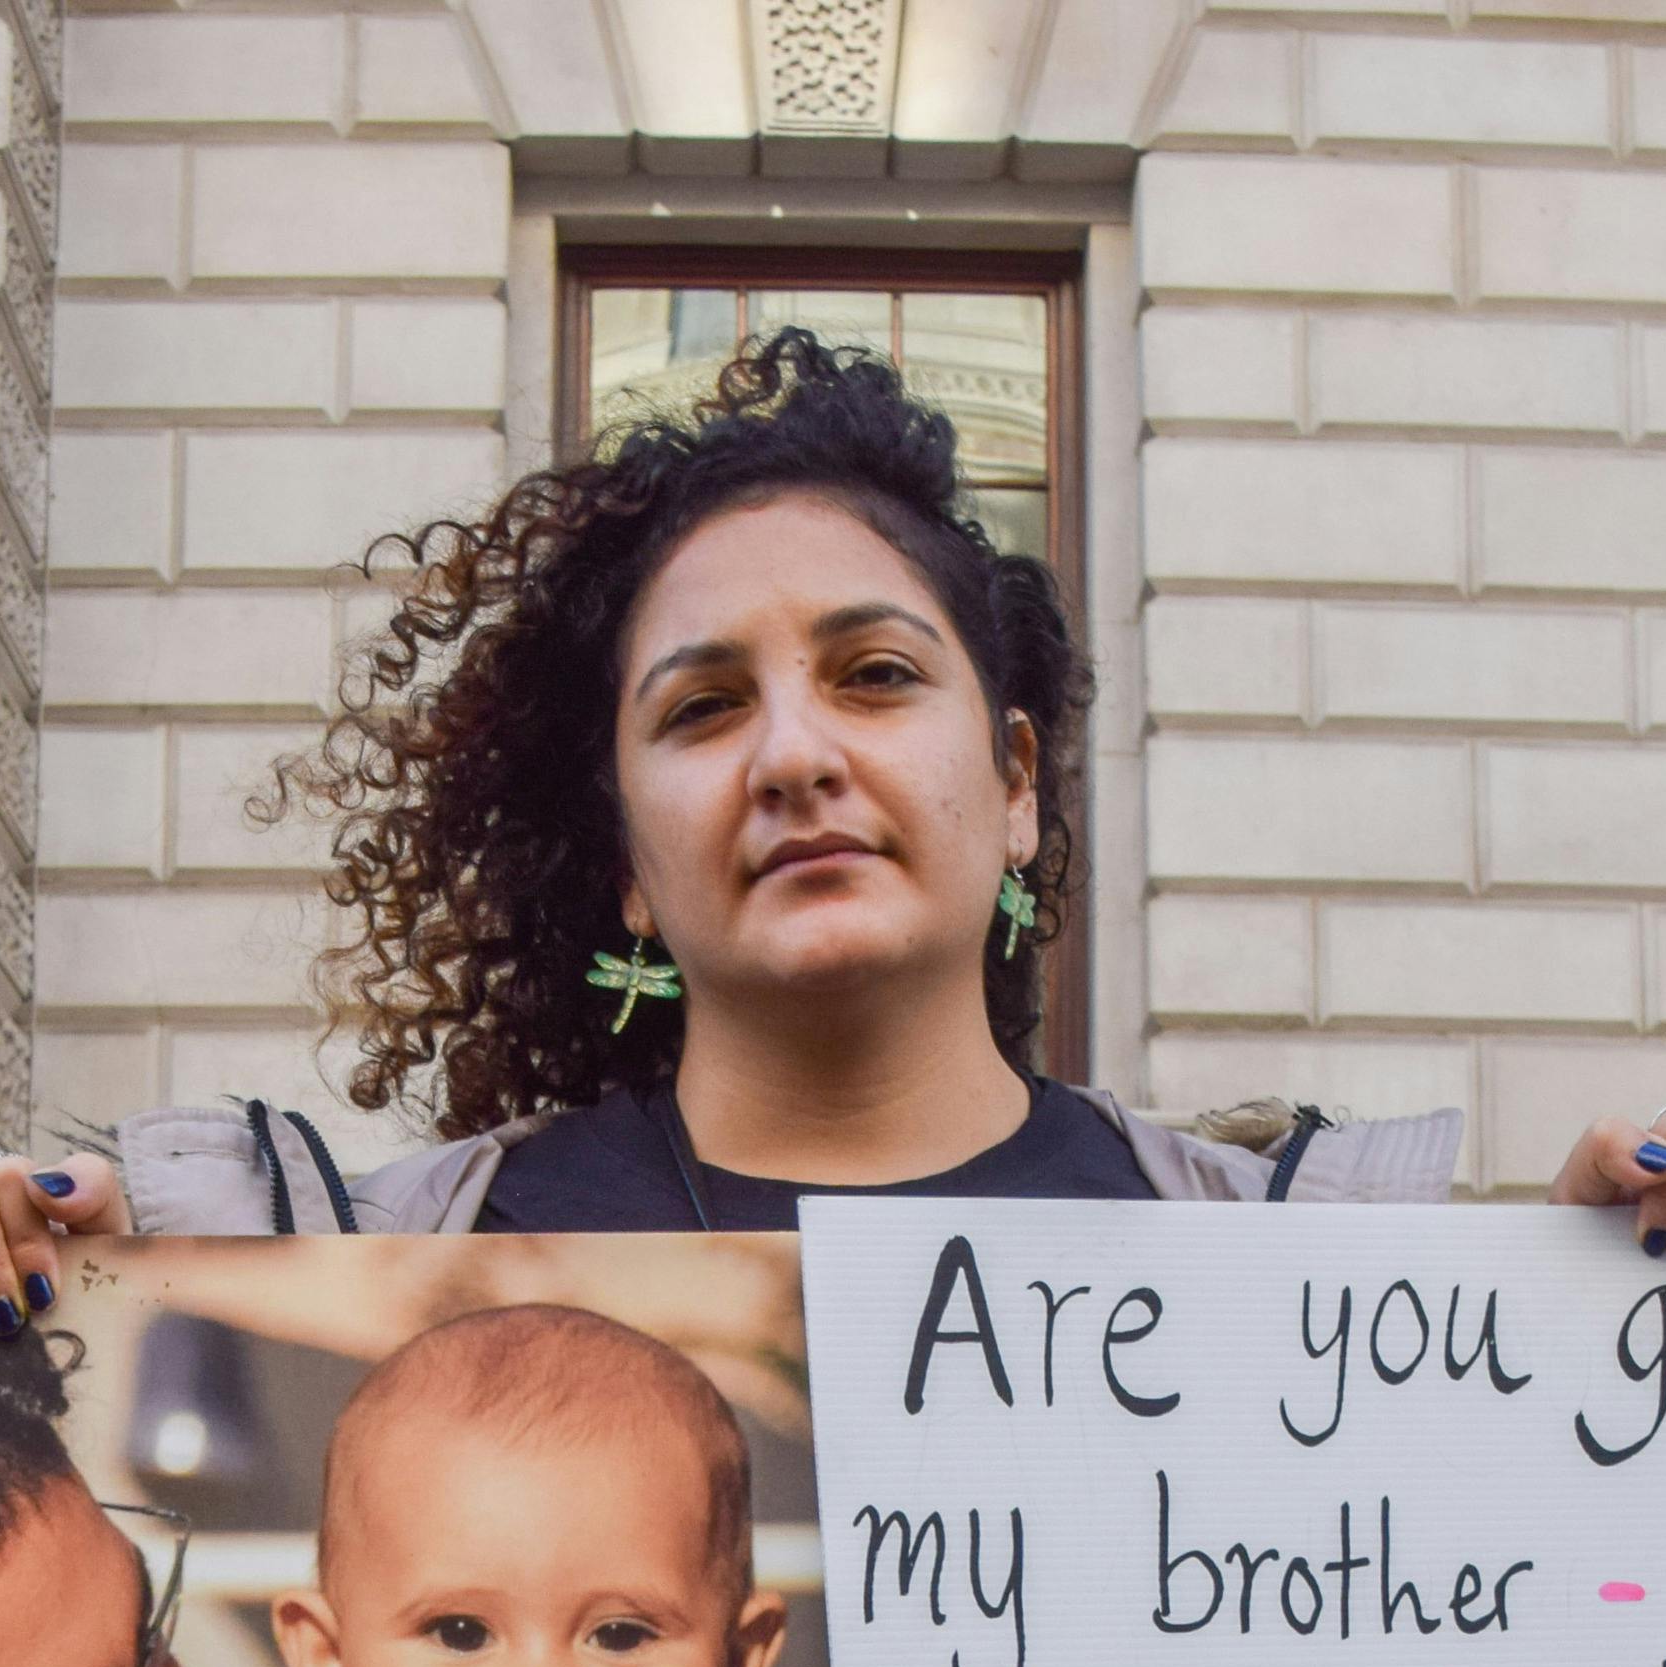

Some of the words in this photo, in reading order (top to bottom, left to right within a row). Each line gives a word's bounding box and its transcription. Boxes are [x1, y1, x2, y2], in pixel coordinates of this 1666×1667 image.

[904, 1235, 1181, 1417] Are
[1279, 1279, 1532, 1447] you
[1152, 1470, 1534, 1640] brother
